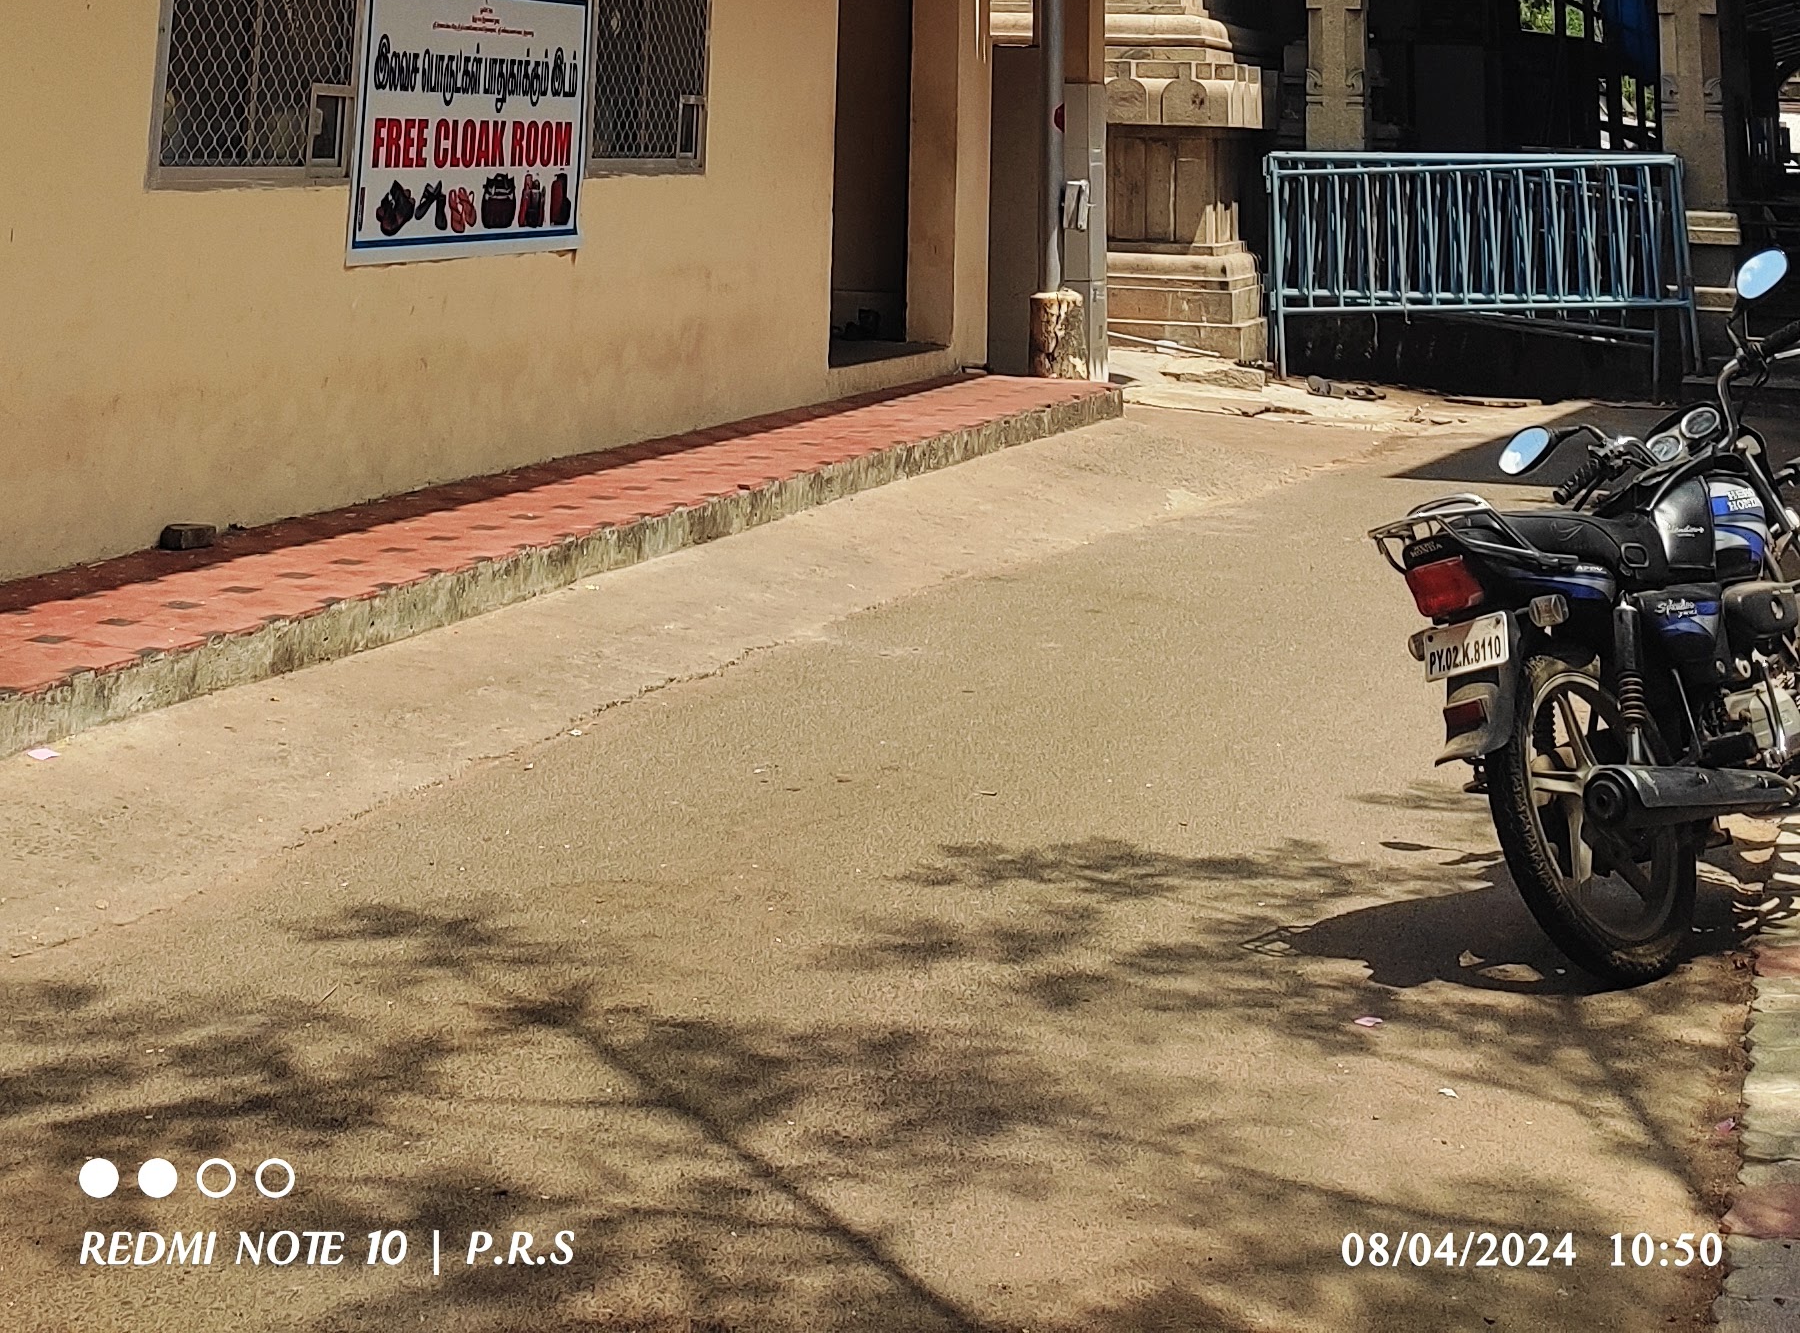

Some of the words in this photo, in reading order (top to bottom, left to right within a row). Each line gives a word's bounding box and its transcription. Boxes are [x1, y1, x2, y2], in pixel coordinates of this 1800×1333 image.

[374, 33, 419, 92] இலவச
[421, 43, 482, 107] பொருட்கள்
[483, 48, 549, 114] பாதுகாக்கும்
[551, 47, 578, 99] இடம்
[372, 118, 429, 169] FREE
[433, 118, 507, 169] CLOAK
[510, 121, 573, 168] ROOM
[1429, 635, 1501, 676] PY.02.K.8110
